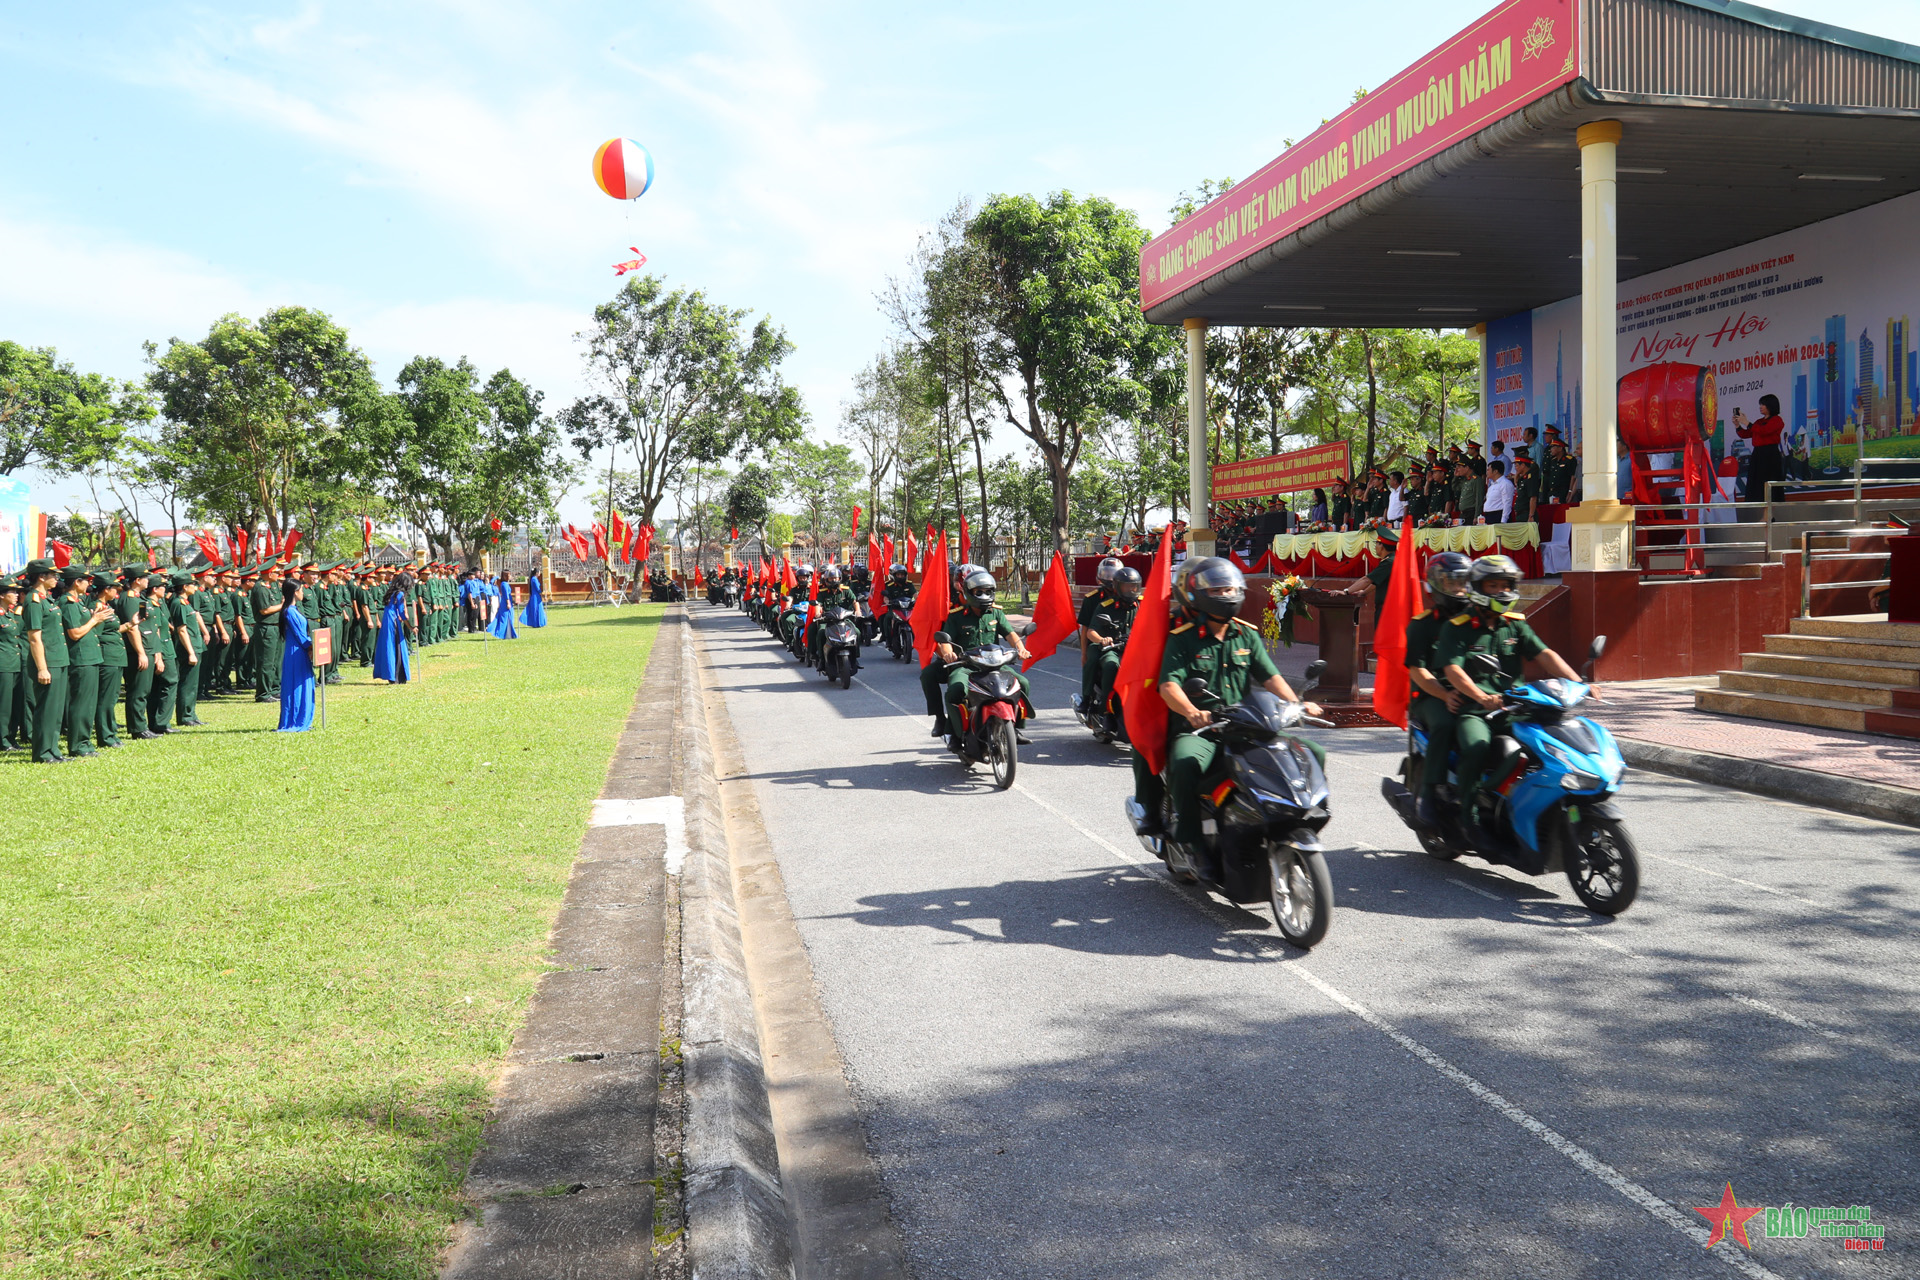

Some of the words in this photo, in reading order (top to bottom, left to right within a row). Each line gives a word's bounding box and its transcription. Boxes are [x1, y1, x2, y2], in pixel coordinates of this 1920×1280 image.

[1159, 242, 1184, 284] ĐẢNG
[1185, 231, 1213, 271] CỘNG
[1215, 206, 1238, 251] SẢN
[1240, 189, 1264, 238] VIỆT
[1267, 174, 1297, 219] NAM
[1300, 141, 1348, 204] QUANG
[1352, 113, 1391, 170] VINH
[1396, 74, 1453, 145] MUÔN
[1459, 36, 1511, 109] NĂM
[1695, 276, 1712, 290] QUÂN
[1713, 271, 1725, 284] ĐỘI
[1726, 267, 1744, 280] NHÂN
[1745, 262, 1760, 275] DÂN
[1761, 257, 1777, 271] VIỆT
[1778, 253, 1795, 266] NAM
[1630, 330, 1699, 363] Ngày
[1705, 311, 1771, 348] Hội
[1719, 358, 1741, 376] GIAO
[1744, 350, 1775, 371] THÔNG
[1777, 344, 1798, 365] NĂM
[1801, 342, 1825, 361] 2024
[1719, 386, 1727, 396] 10
[1728, 383, 1744, 394] năm
[1746, 380, 1764, 392] 2024
